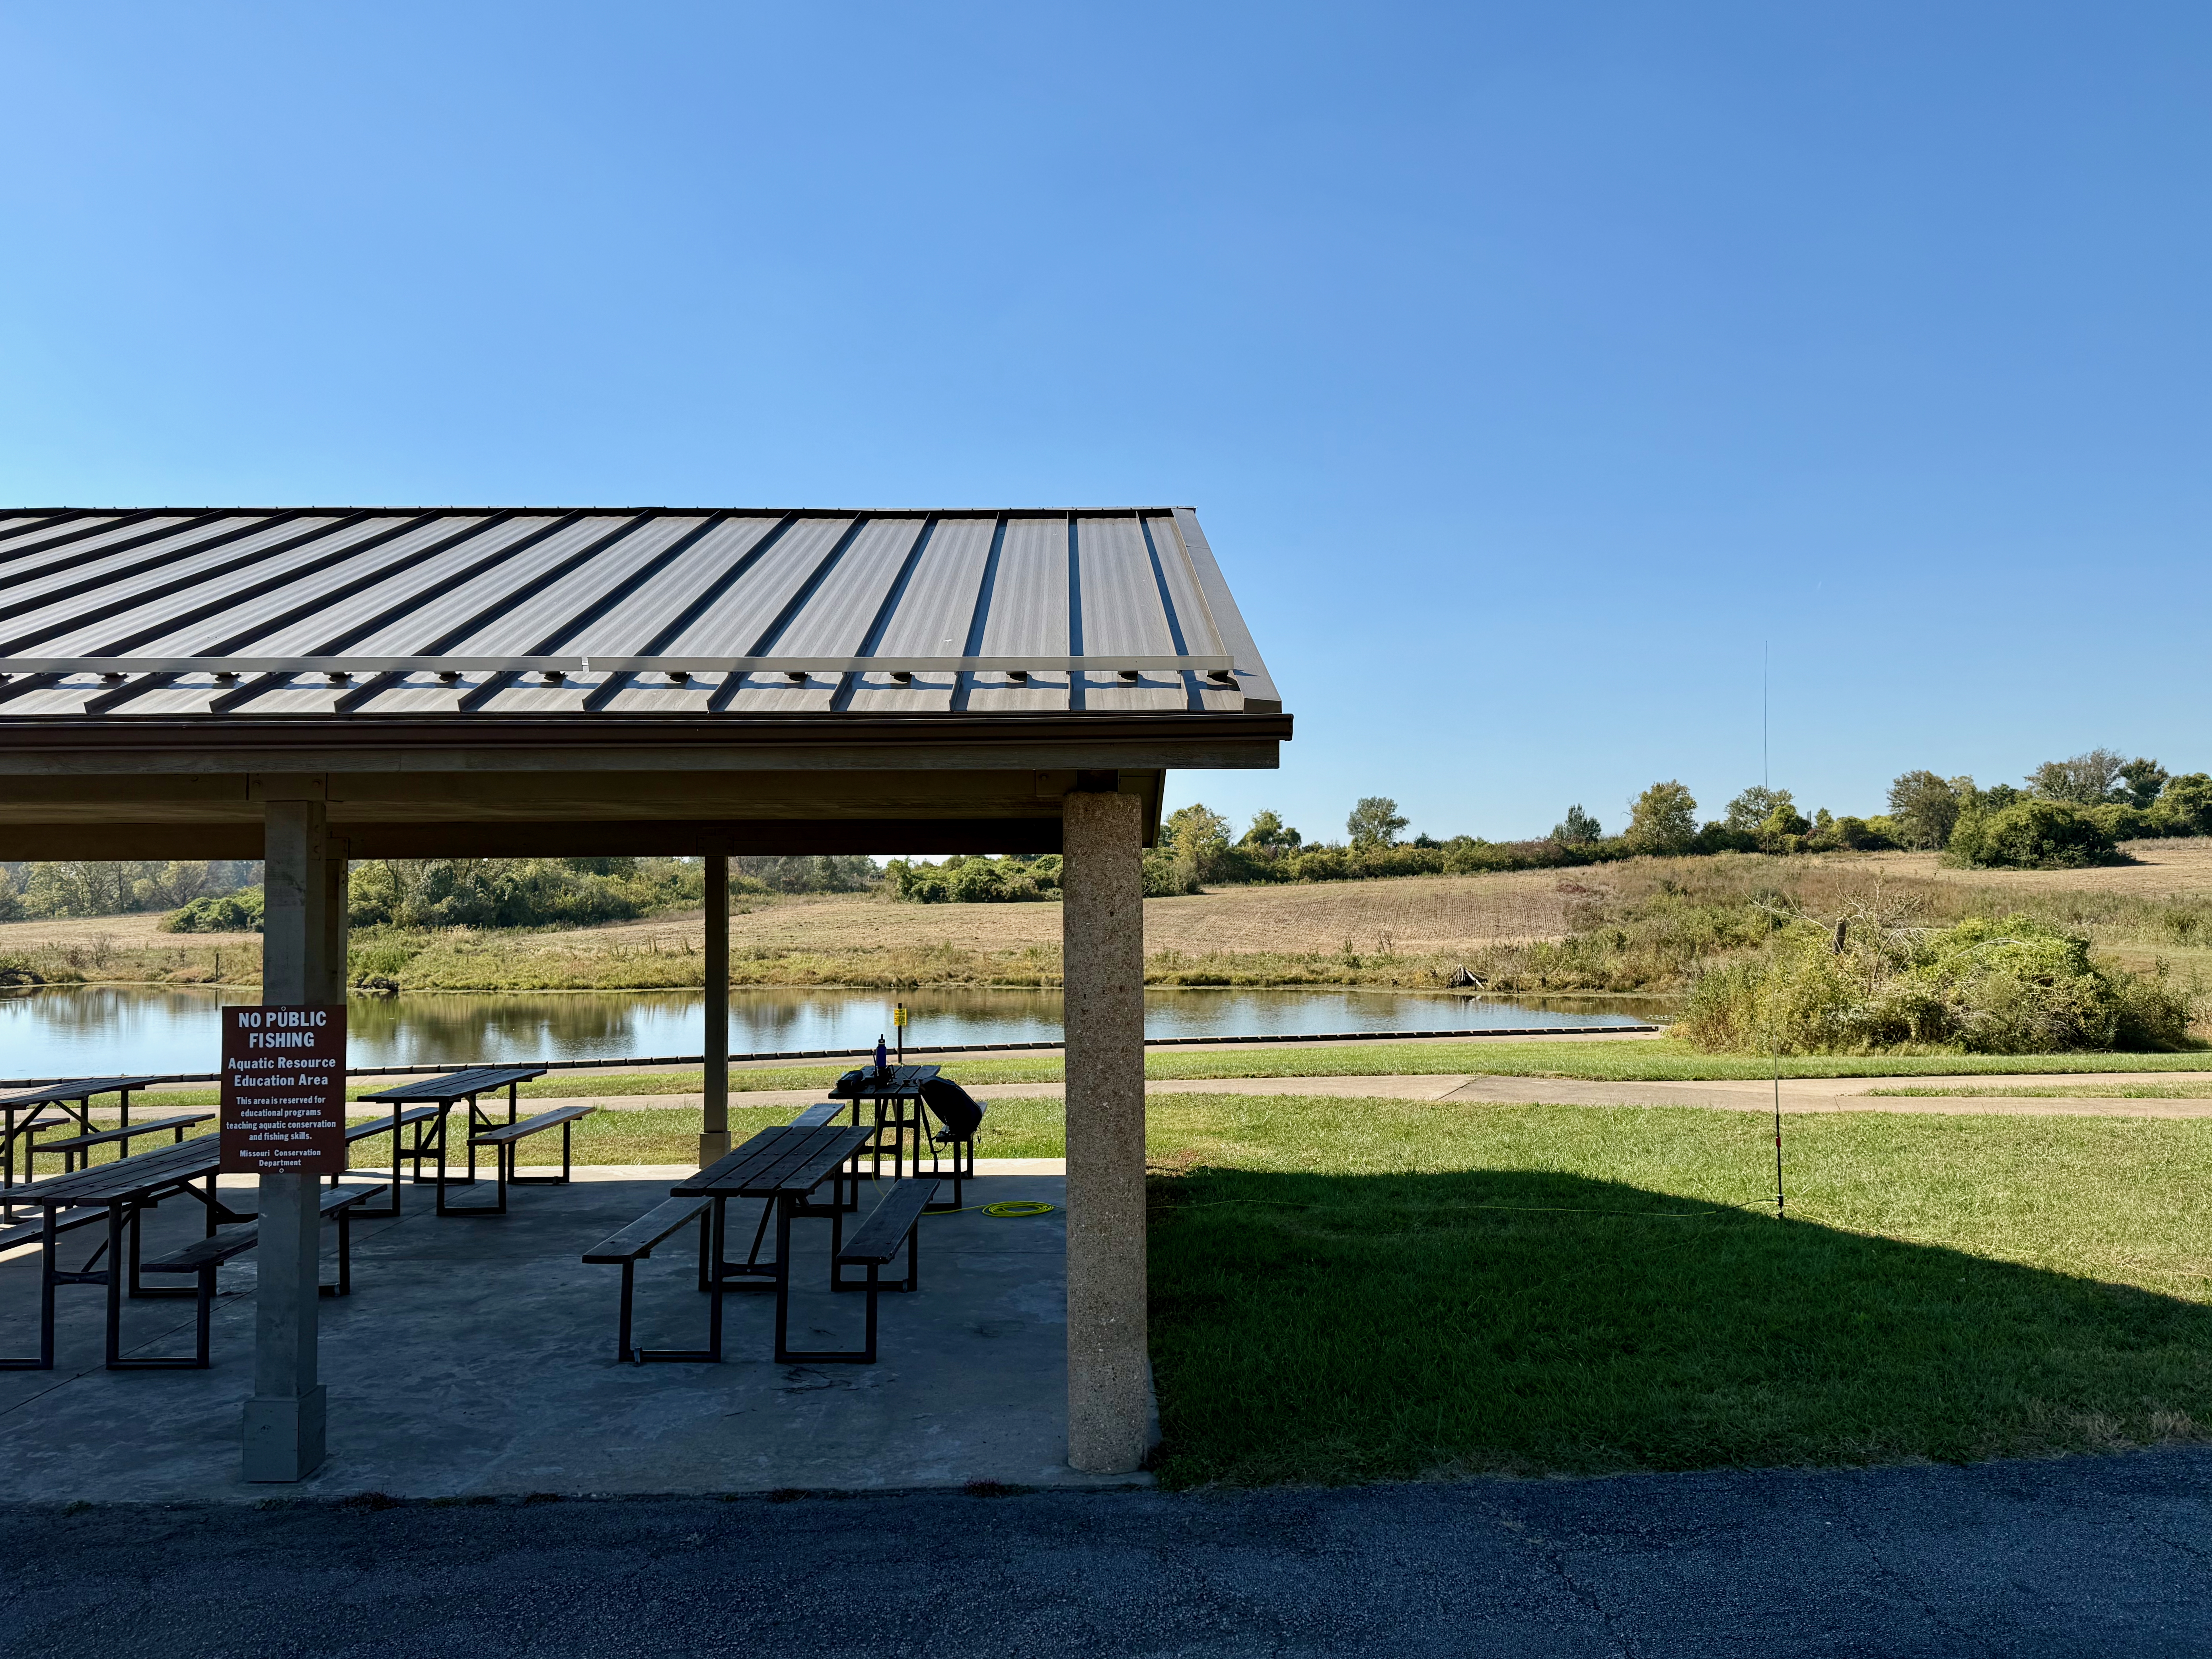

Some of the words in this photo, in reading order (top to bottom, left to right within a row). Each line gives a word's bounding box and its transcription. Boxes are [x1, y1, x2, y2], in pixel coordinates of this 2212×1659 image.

[239, 1013, 261, 1027] NO
[266, 1011, 326, 1027] PUBLIC
[249, 1032, 314, 1048] FISHING
[228, 1057, 274, 1071] Aquatic
[278, 1057, 335, 1068] Resource
[235, 1075, 294, 1086] Education
[299, 1074, 328, 1085] Area
[241, 1108, 283, 1117] educational
[226, 1122, 257, 1130] teaching
[259, 1121, 286, 1130] aquatic
[264, 1132, 288, 1141] fishing
